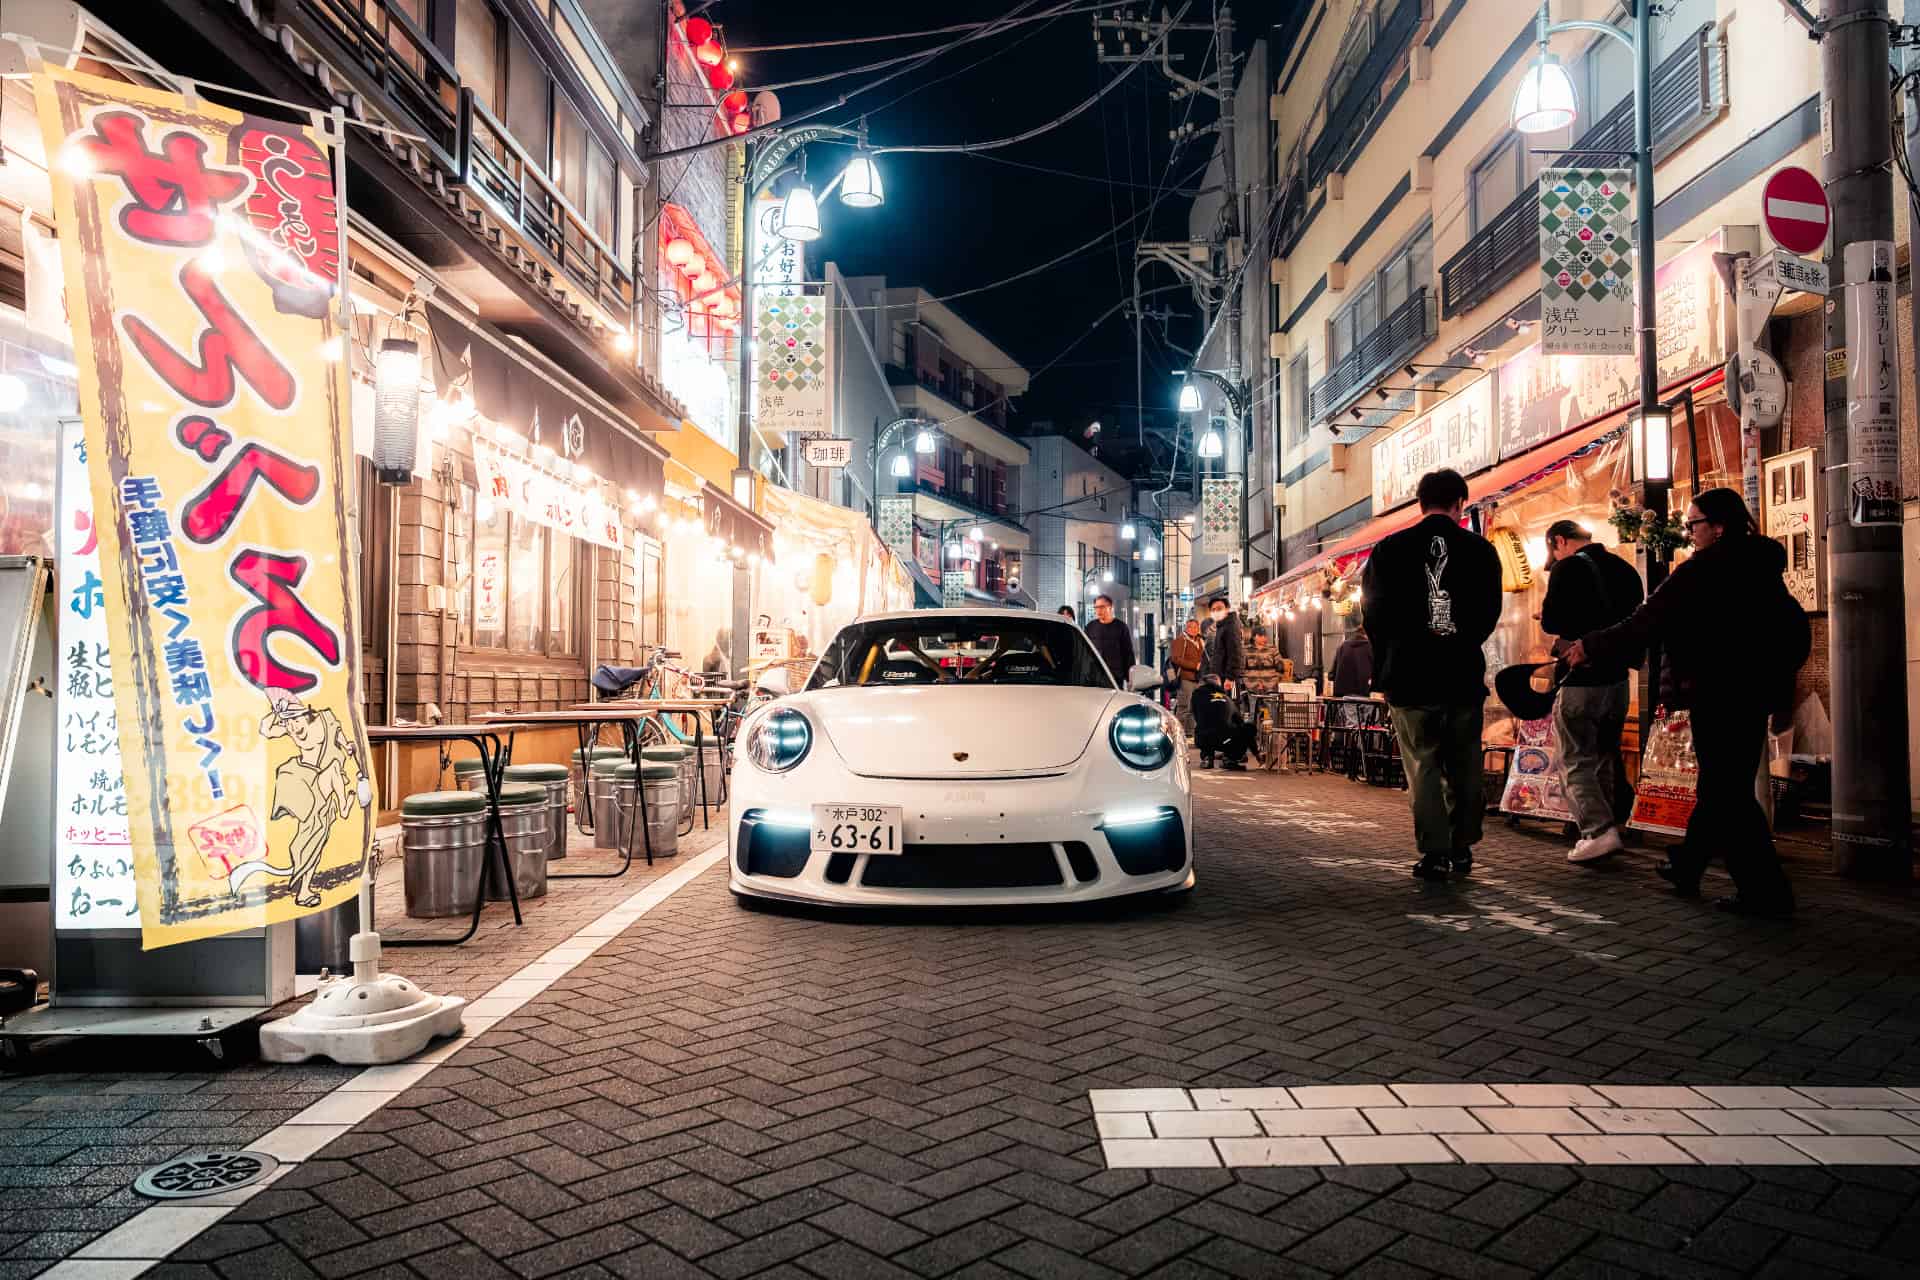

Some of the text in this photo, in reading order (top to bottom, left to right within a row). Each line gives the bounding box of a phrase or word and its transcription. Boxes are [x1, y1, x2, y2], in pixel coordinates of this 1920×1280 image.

[1546, 308, 1580, 323] 浅草
[1546, 327, 1632, 338] グリーンロード
[812, 446, 846, 463] 珈琲
[832, 807, 883, 822] 水戸 302
[816, 823, 895, 851] ち 63-61
